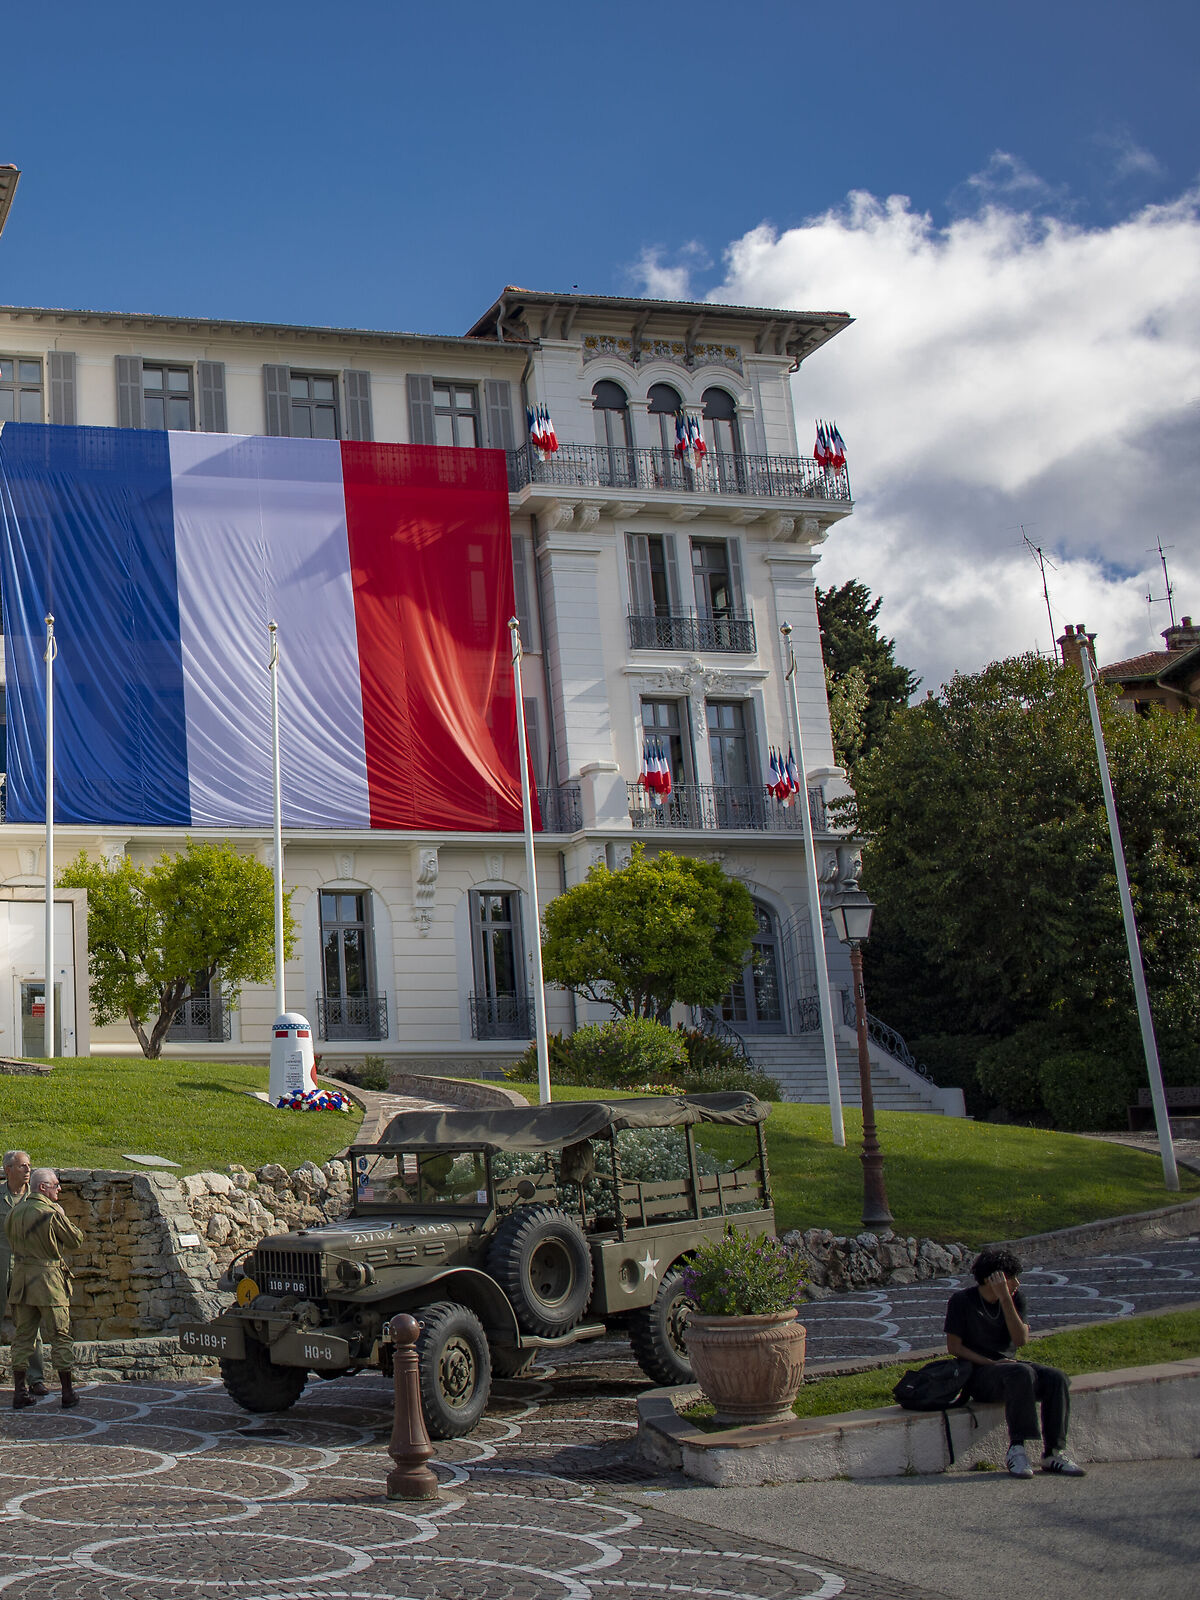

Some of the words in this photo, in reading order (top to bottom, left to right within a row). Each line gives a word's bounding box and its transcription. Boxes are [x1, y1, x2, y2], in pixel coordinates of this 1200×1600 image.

[285, 1282, 290, 1291] P
[293, 1283, 305, 1292] 06
[245, 1290, 251, 1301] 4
[183, 1331, 227, 1350] 45-189-F
